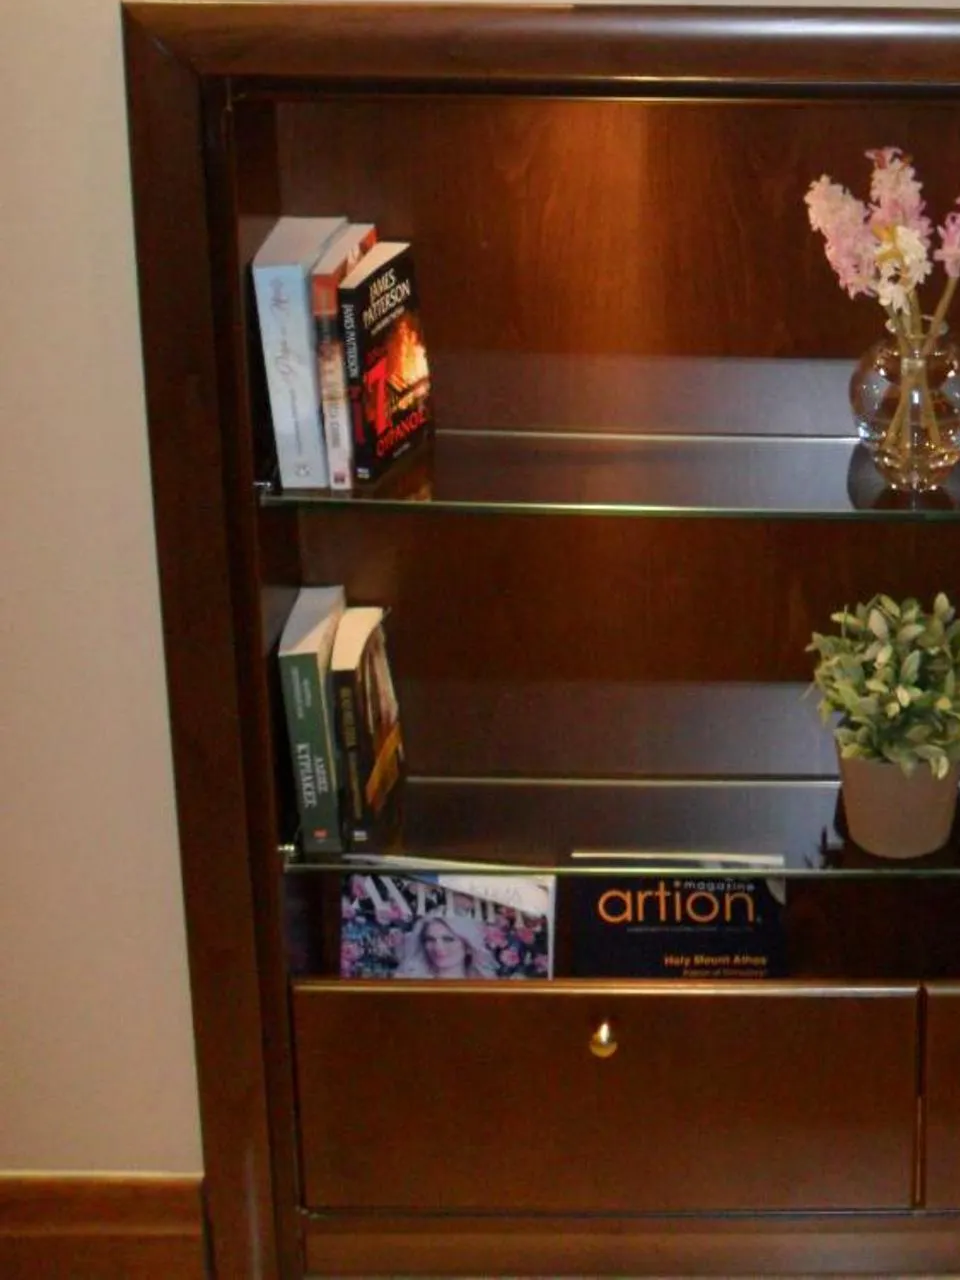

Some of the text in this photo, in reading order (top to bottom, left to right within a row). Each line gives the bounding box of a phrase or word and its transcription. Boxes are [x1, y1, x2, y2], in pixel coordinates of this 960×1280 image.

[362, 278, 411, 329] PATTERSON
[369, 267, 397, 306] JAMES
[598, 879, 756, 922] artion
